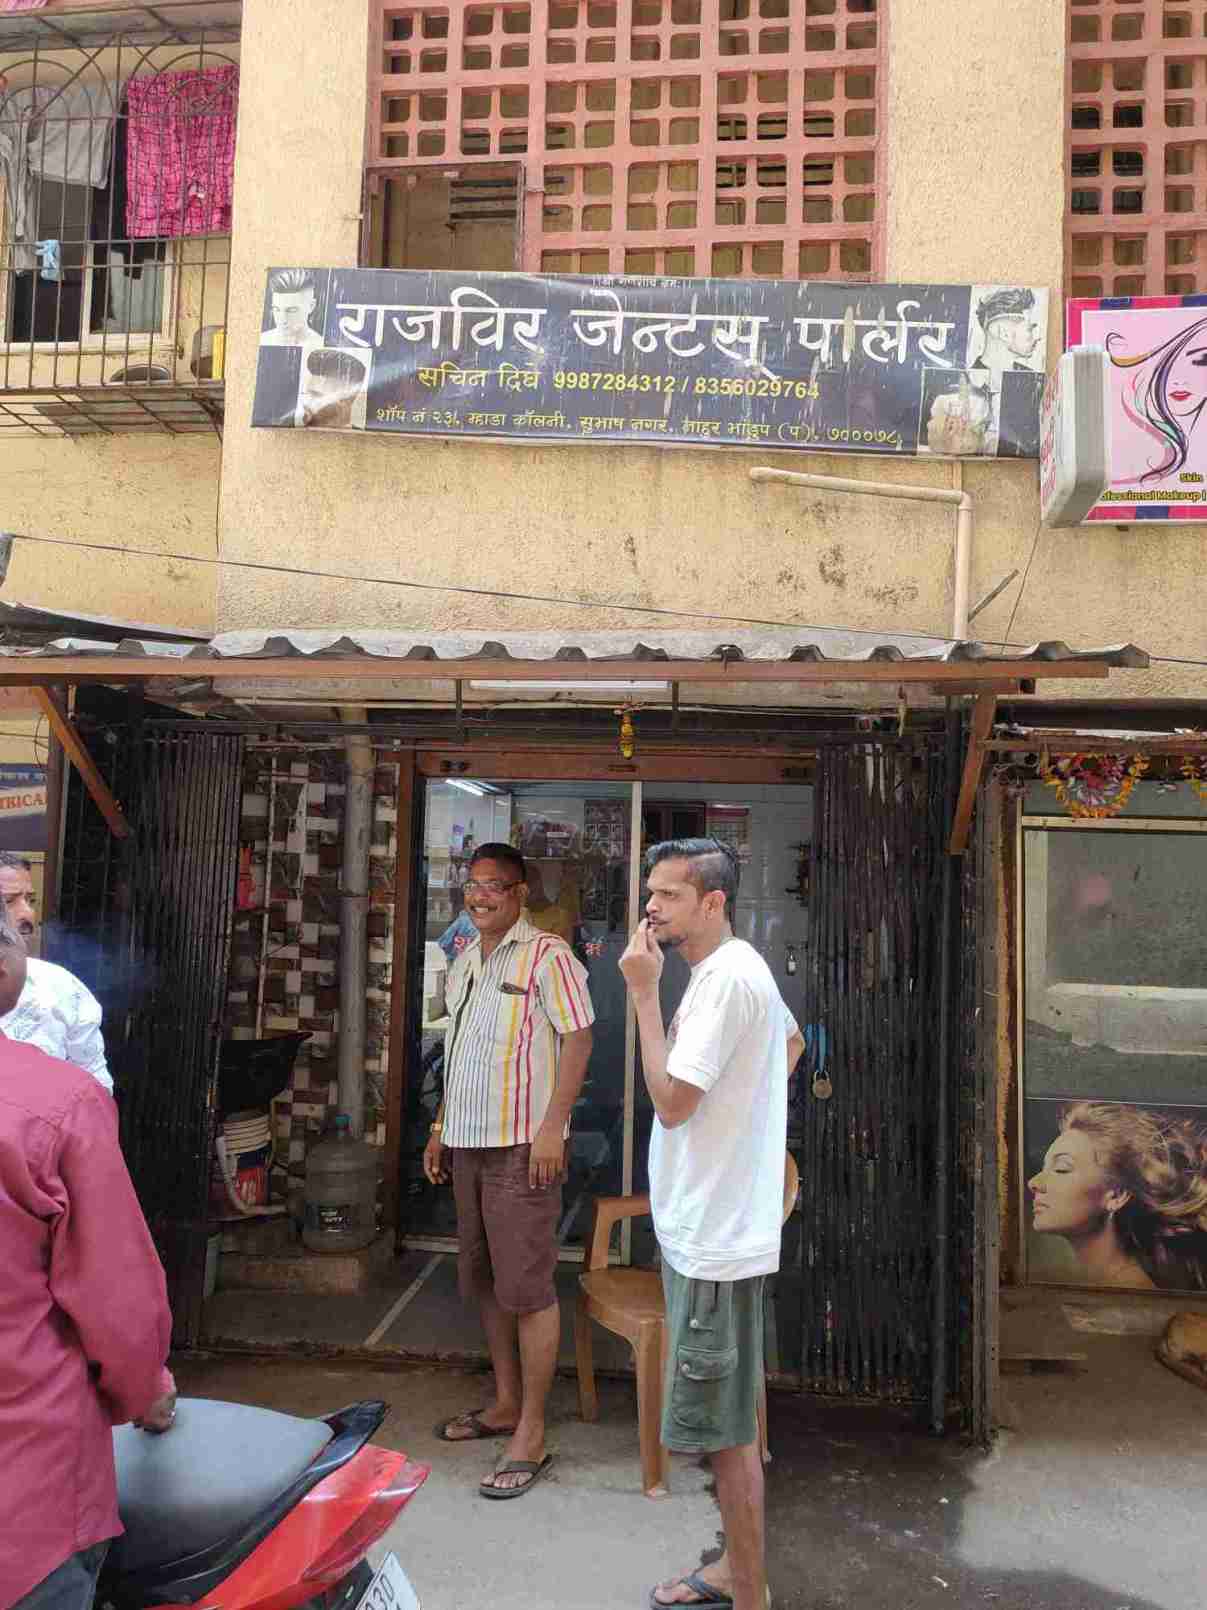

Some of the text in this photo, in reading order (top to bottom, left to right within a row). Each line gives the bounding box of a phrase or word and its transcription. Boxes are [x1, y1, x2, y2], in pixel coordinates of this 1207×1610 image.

[335, 286, 548, 356] राजविर
[792, 300, 956, 368] पार्लर
[415, 360, 489, 389] सचिन
[553, 371, 676, 393] 9987284312
[695, 376, 820, 400] 8356029764
